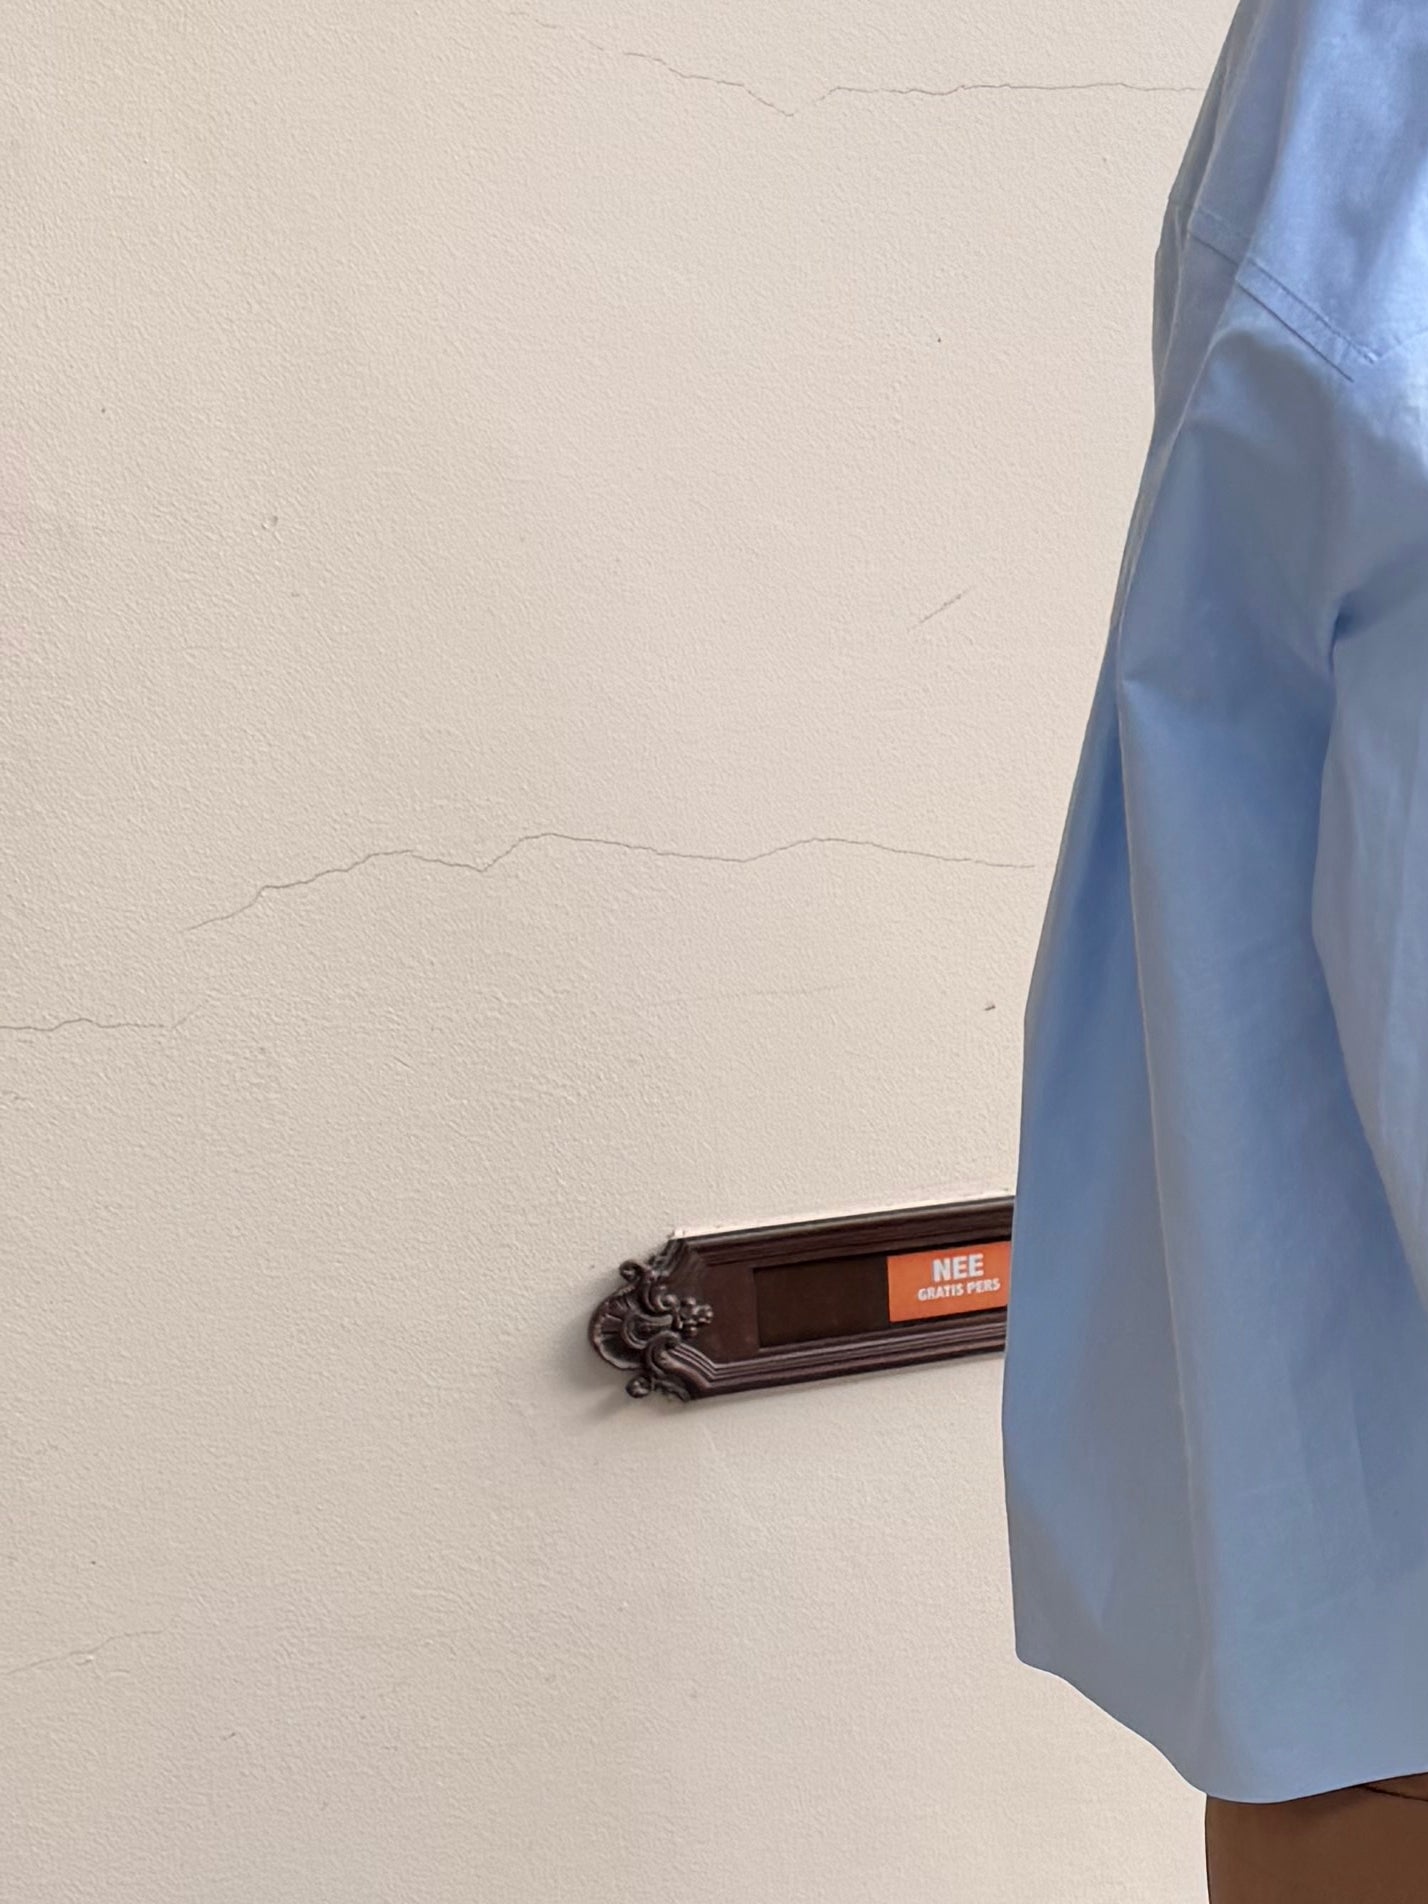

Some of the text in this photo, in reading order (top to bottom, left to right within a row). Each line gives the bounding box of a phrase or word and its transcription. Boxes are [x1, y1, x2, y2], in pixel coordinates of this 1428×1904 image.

[932, 1253, 985, 1282] NEE
[917, 1278, 1000, 1301] GRATIS PERS
